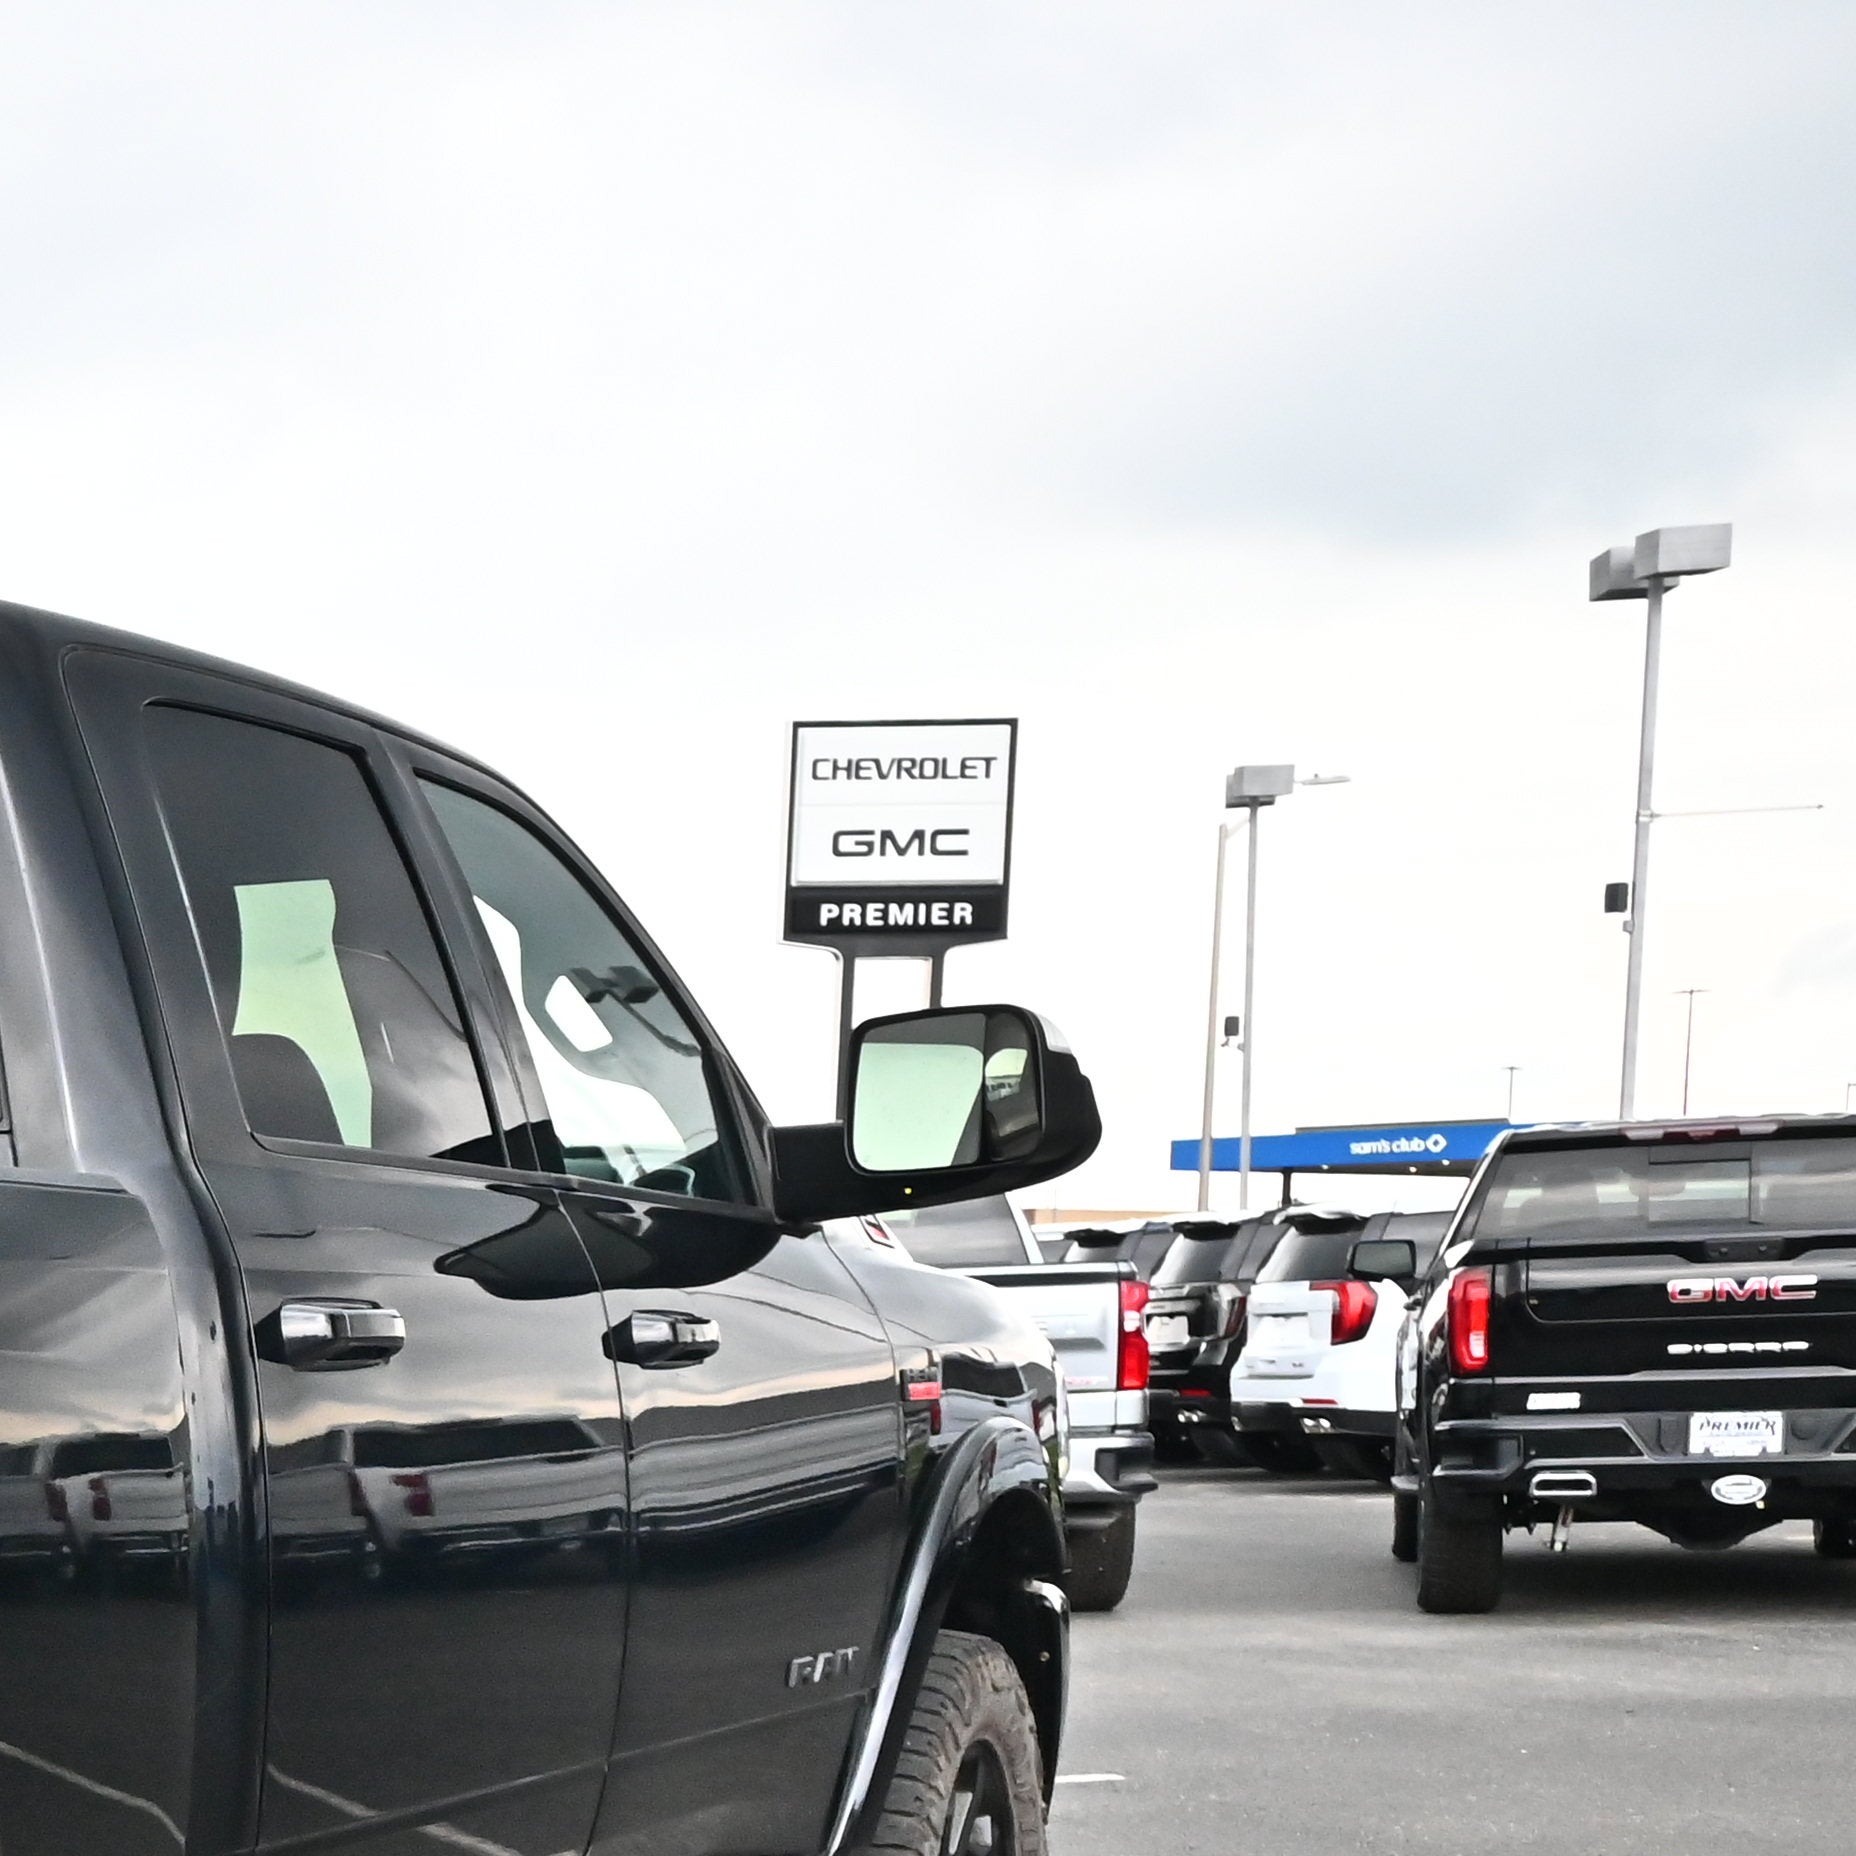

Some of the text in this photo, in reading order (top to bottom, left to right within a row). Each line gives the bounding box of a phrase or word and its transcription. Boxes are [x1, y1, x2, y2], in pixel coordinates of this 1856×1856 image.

[811, 756, 998, 780] CHEVROLET
[831, 829, 971, 857] GMC
[819, 902, 974, 927] PREMIER
[1350, 1137, 1426, 1155] sam's club
[1667, 1274, 1819, 1304] GMC
